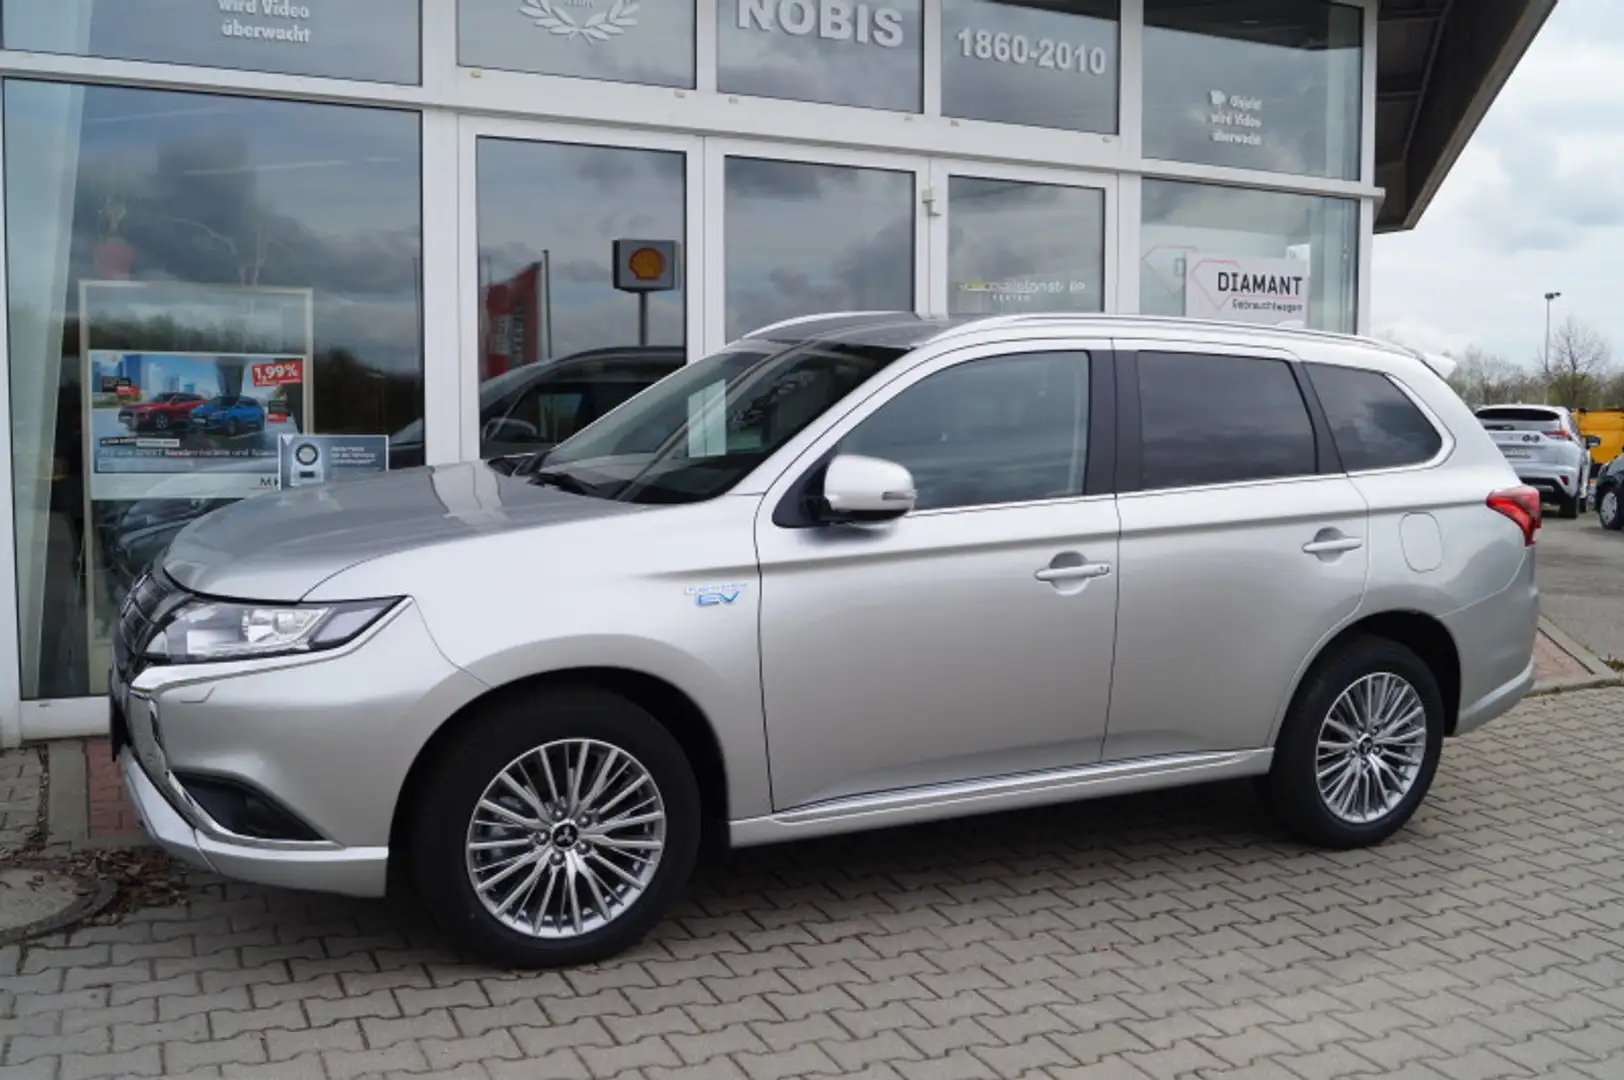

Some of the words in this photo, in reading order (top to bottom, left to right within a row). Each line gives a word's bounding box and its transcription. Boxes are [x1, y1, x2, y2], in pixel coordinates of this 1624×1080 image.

[262, 0, 311, 19] Video
[737, 0, 904, 47] NOBIS
[957, 26, 1107, 75] 1860-2010
[1217, 270, 1304, 297] DIAMANT
